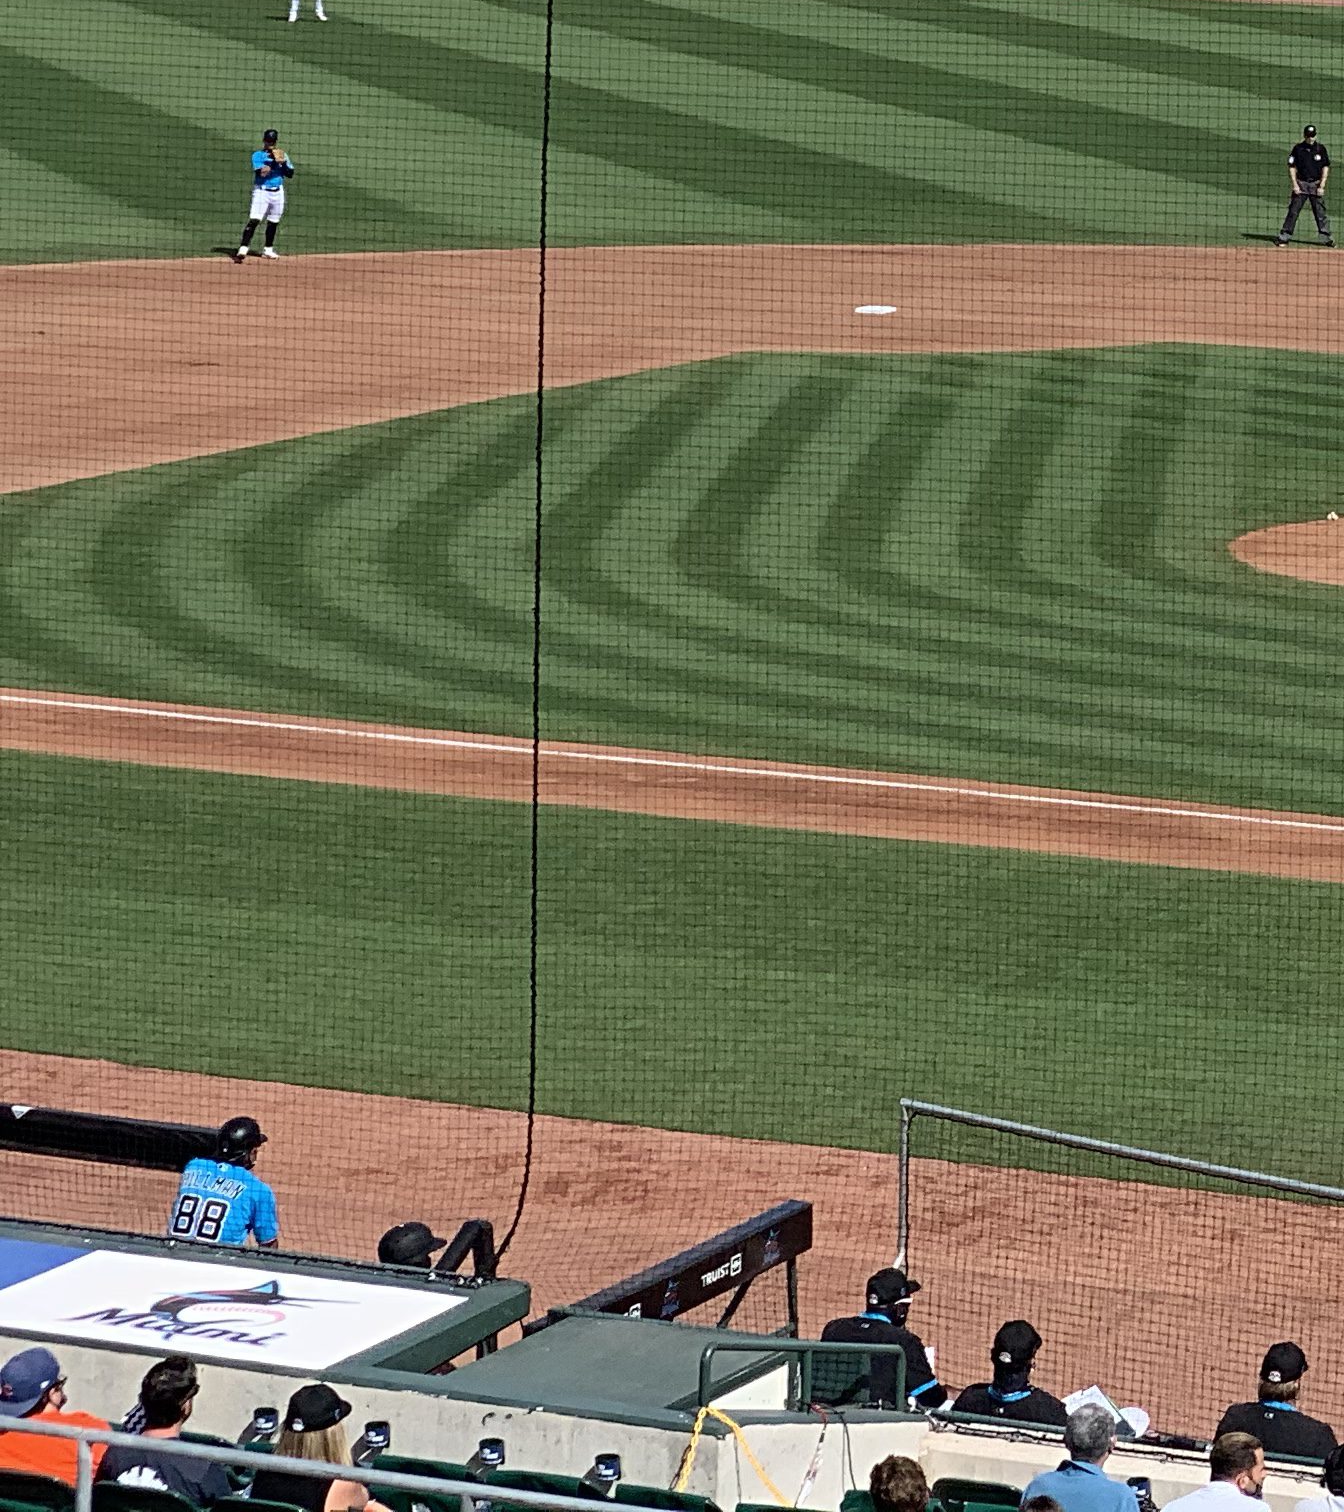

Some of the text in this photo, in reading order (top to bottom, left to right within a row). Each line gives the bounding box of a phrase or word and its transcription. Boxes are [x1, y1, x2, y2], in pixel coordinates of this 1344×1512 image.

[171, 1193, 231, 1243] 88
[701, 1262, 731, 1287] TRUIST
[53, 1306, 288, 1346] Miami
